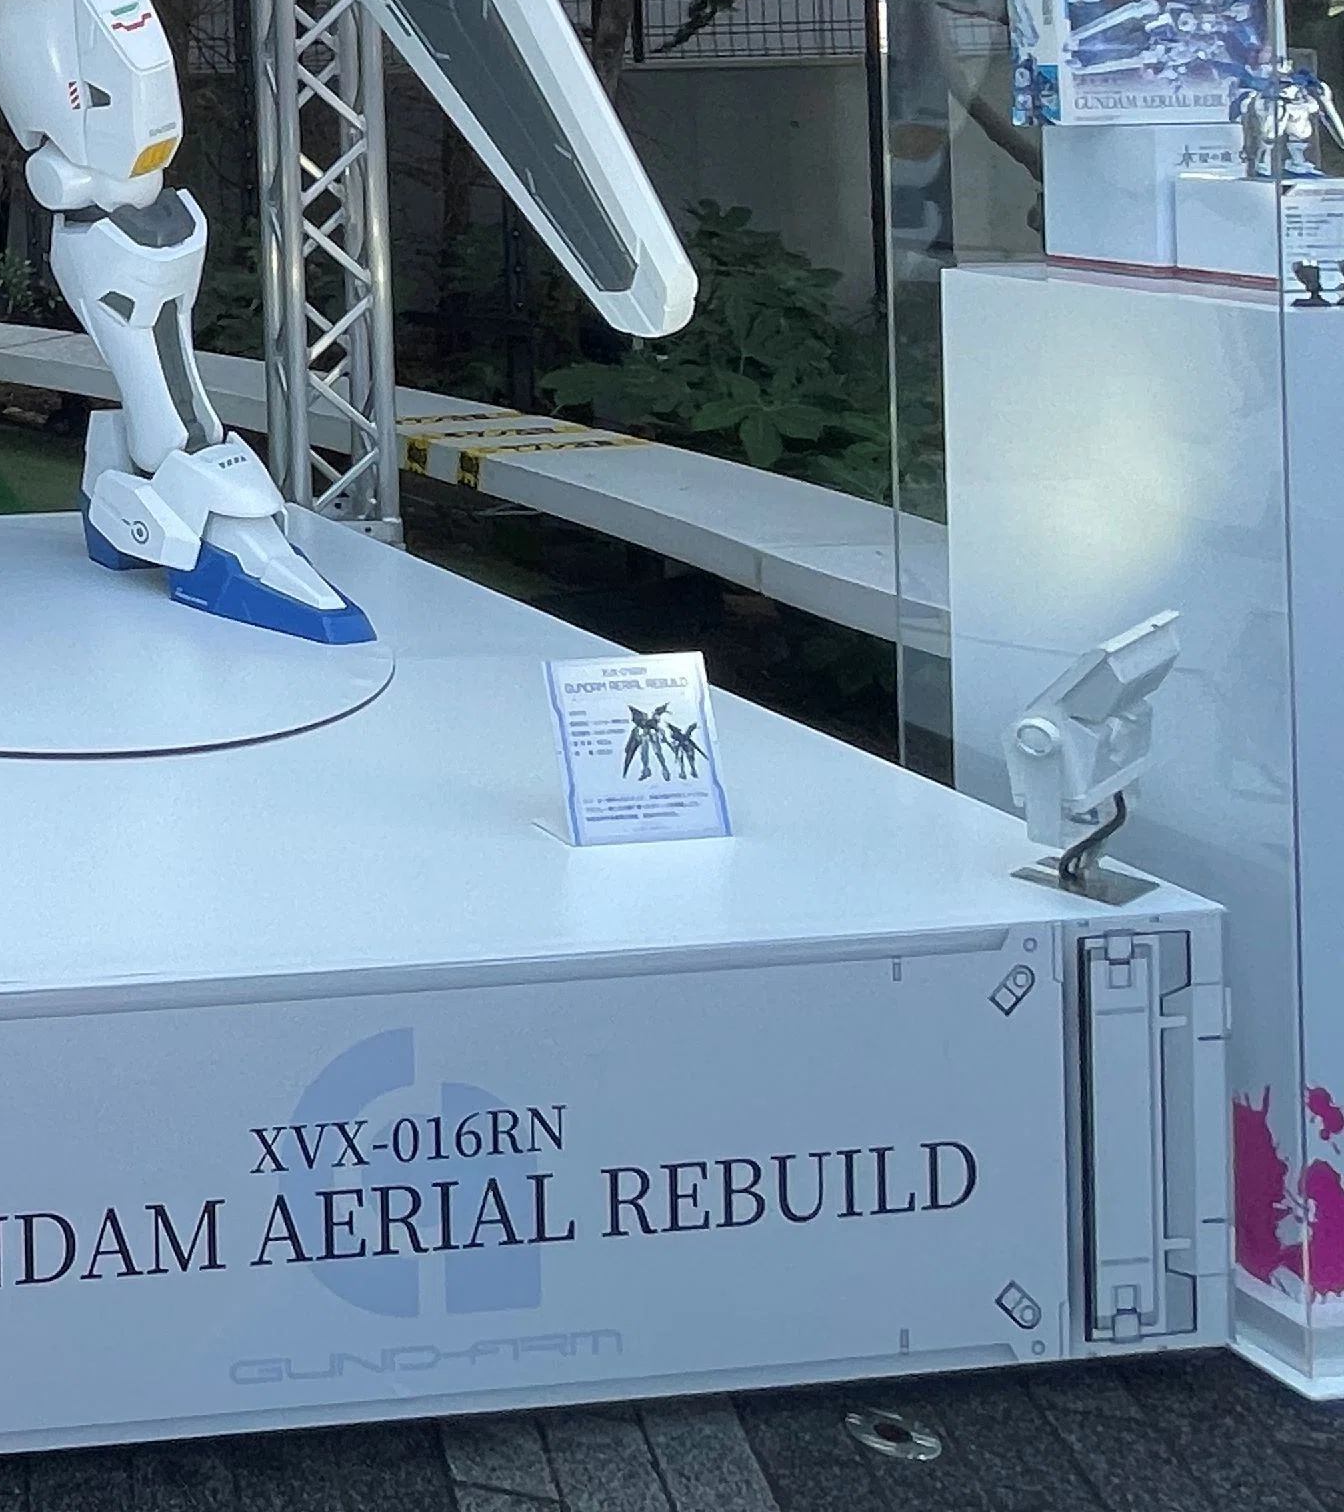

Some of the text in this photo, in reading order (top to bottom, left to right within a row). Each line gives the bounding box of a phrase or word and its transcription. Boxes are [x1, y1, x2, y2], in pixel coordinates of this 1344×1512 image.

[249, 1103, 569, 1174] XVX-016RN
[249, 1172, 577, 1267] AERIAL
[600, 1140, 979, 1238] REBUILD
